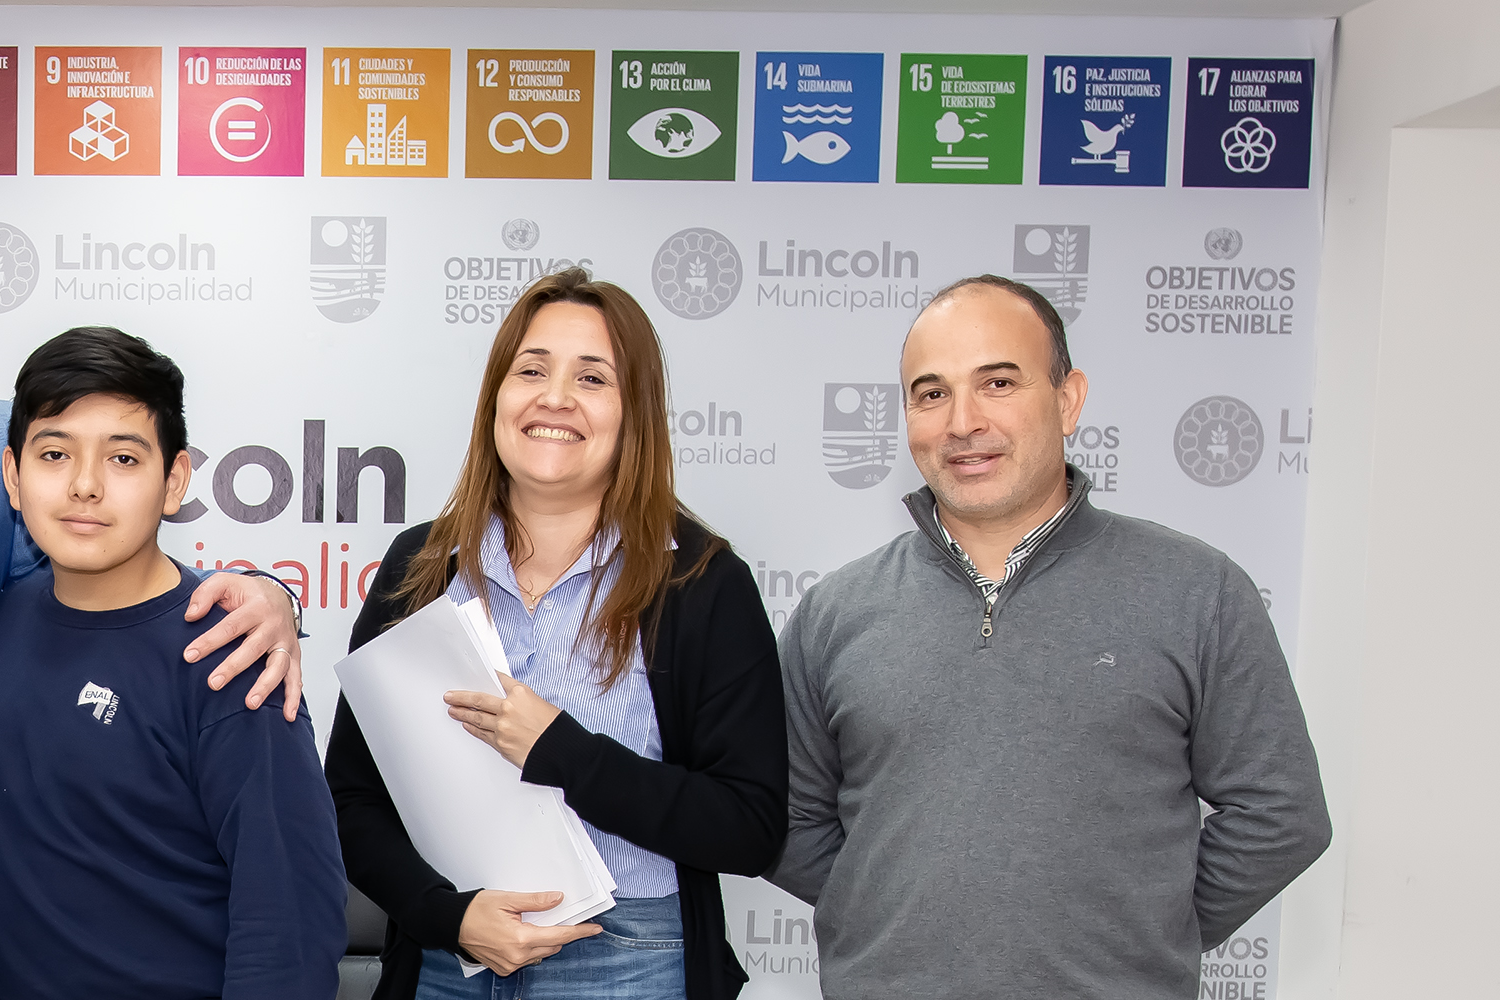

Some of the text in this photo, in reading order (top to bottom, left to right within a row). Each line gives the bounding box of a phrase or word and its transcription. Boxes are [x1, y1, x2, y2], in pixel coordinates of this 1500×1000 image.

[46, 57, 61, 84] 9
[68, 56, 119, 70] INDUSTRIA,
[185, 57, 209, 84] 10
[216, 56, 301, 71] REDUCCIÓN DE LAS
[359, 58, 413, 71] CIUDADES Y
[509, 58, 570, 73] PRODUCCIÓN
[650, 61, 686, 76] ACCIÓN
[798, 64, 821, 77] VIDA
[68, 69, 131, 84] INNOVACIÓN E
[331, 58, 351, 85] 11
[475, 59, 498, 87] 12
[619, 60, 643, 89] 13
[763, 62, 787, 90] 14
[909, 64, 932, 91] 15
[942, 66, 964, 79] VIDA
[1052, 65, 1076, 93] 16
[1086, 68, 1151, 82] PAZ, JUSTICIA
[1230, 70, 1302, 84] ALIANZAS PARA
[216, 73, 291, 86] DESIGUALDADES
[358, 73, 426, 86] COMUNIDADES
[509, 74, 563, 87] Y CONSUMO
[650, 78, 711, 92] POR EL CLIMA
[797, 79, 853, 93] SUBMARINA
[1198, 68, 1221, 96] 17
[68, 86, 154, 98] INFRAESTRUCTURA
[358, 87, 419, 100] SOSTENIBLES
[941, 81, 1016, 94] DE ECOSISTEMAS
[1086, 84, 1161, 97] E INSTITUCIONES
[1230, 85, 1266, 98] LOGRAR
[508, 89, 581, 102] RESPONSABLES
[941, 96, 996, 109] TERRESTRES
[1085, 97, 1124, 112] SÓLIDAS
[1229, 100, 1299, 113] LOS OBJETIVOS
[55, 233, 216, 270] Lincoln
[758, 240, 919, 278] Lincoln
[1145, 266, 1295, 291] OBJETIVOS
[54, 276, 252, 306] Municipalidad
[445, 285, 469, 300] DE
[757, 283, 937, 312] Municipalida
[1146, 293, 1293, 311] DE DESARROLLO
[1145, 313, 1293, 335] SOSTENIBLE
[104, 694, 120, 725] LINCOLN
